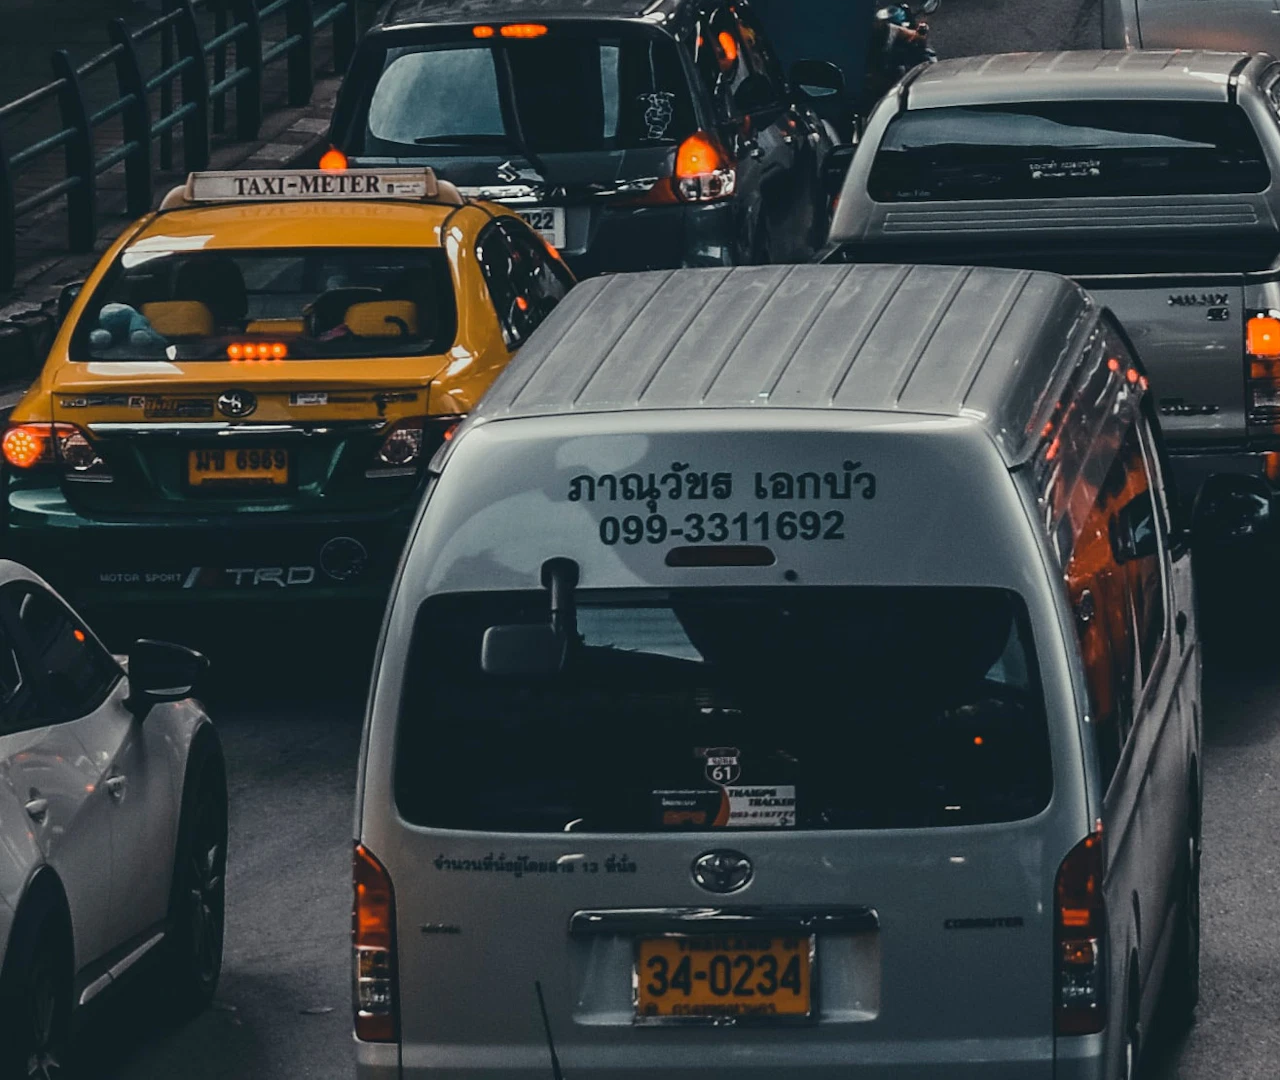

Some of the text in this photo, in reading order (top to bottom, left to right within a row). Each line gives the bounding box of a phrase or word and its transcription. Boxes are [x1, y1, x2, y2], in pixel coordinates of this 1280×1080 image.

[234, 174, 381, 195] TAXI-METER
[567, 460, 876, 513] ภาณุวัชร เอกบัว
[599, 510, 845, 545] 099-3311692
[100, 572, 182, 583] MOTOR SPORT
[225, 566, 315, 588] TRD
[711, 766, 732, 781] 61
[646, 954, 802, 996] 34-0234
